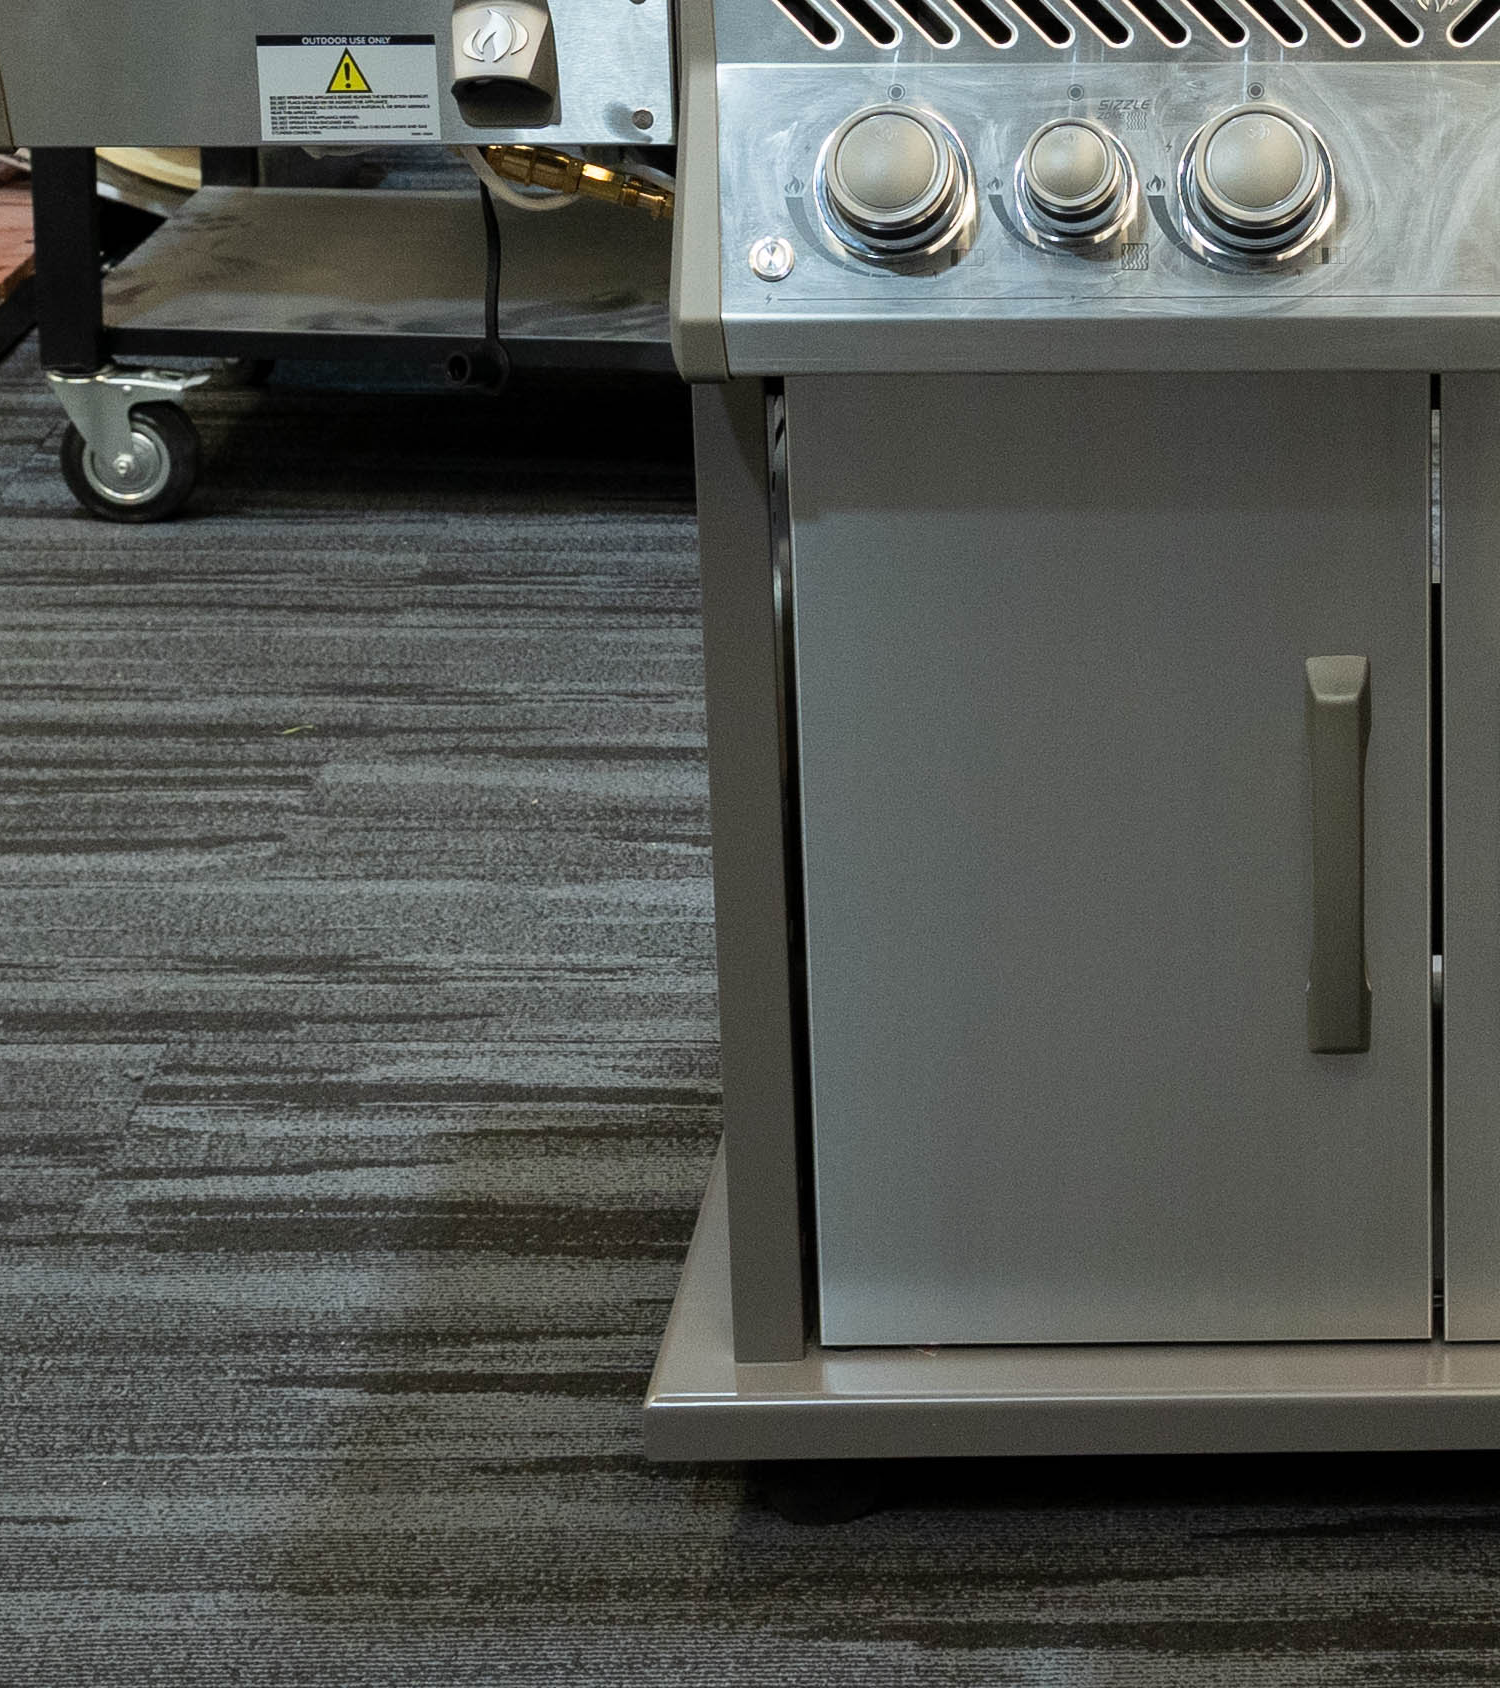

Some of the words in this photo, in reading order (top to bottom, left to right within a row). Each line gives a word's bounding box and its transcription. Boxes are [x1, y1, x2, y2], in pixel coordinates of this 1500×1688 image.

[301, 36, 348, 45] OUTDOOR
[349, 36, 366, 45] USE
[368, 36, 391, 44] ONLY
[1098, 99, 1152, 111] SIZZLE
[1097, 111, 1125, 120] ZONE
